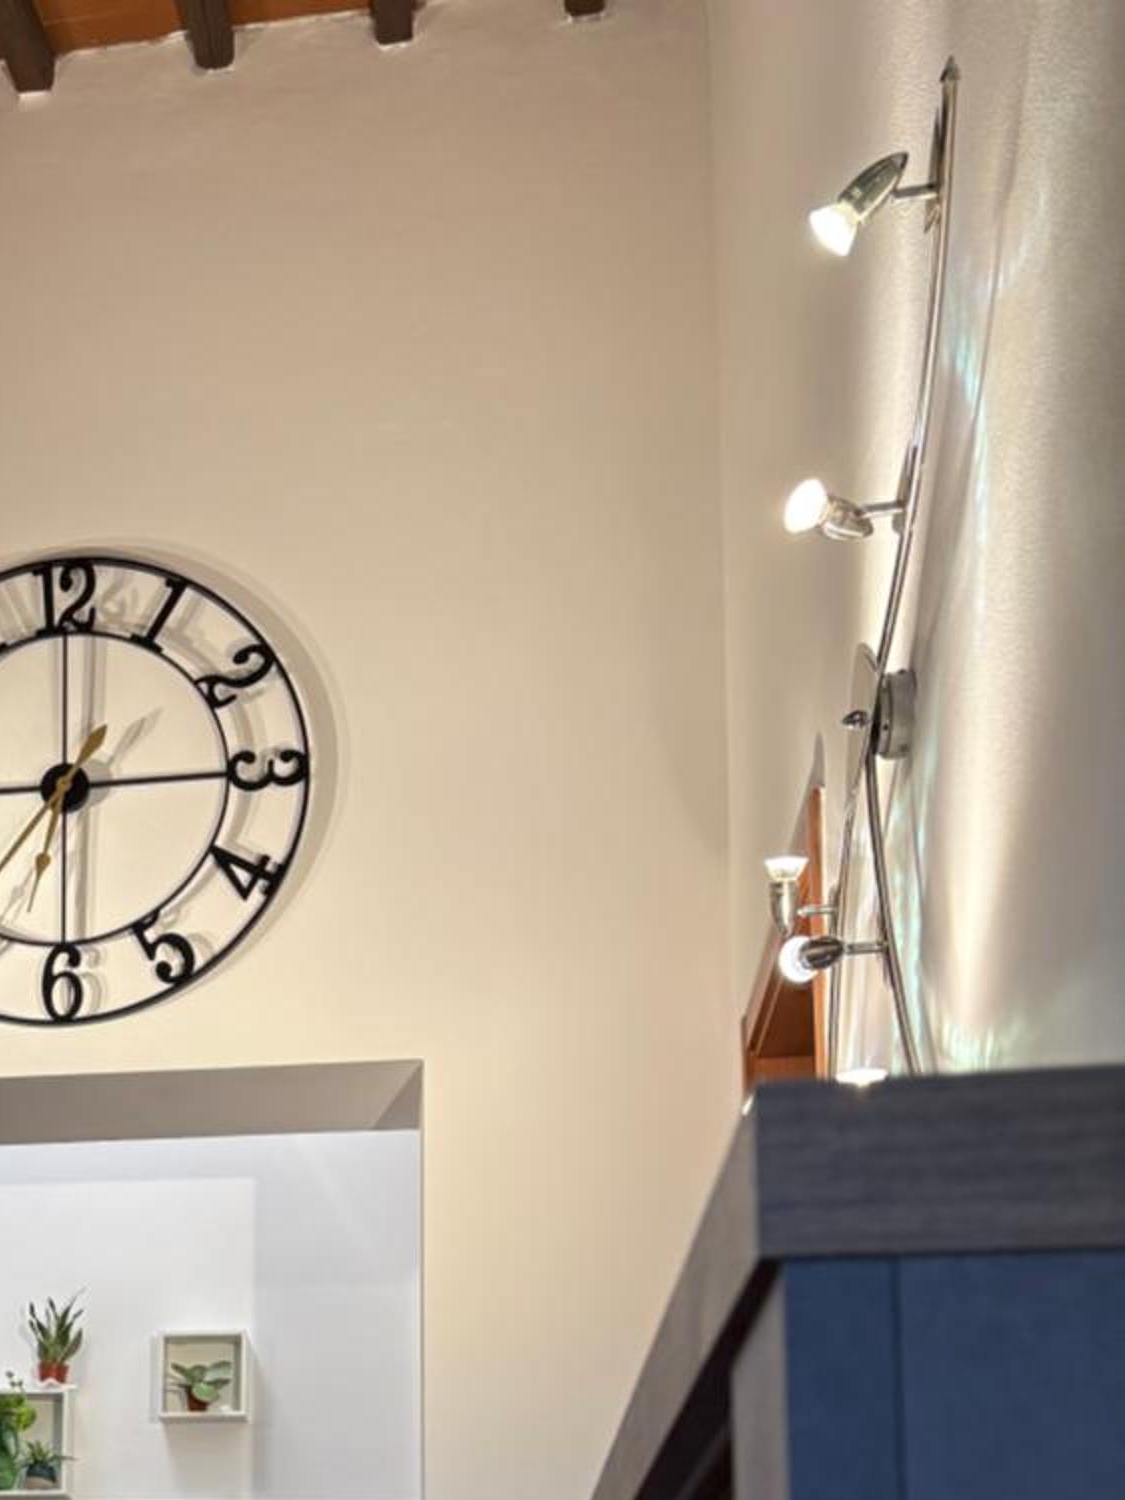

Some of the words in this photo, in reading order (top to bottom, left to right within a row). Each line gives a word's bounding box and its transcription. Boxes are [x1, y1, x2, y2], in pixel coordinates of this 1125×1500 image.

[32, 561, 95, 636] 12
[131, 578, 187, 652] 1
[195, 643, 275, 707] 2
[227, 748, 308, 791] 3
[211, 846, 285, 901] 4
[42, 943, 83, 1022] 6
[132, 911, 196, 985] 5
